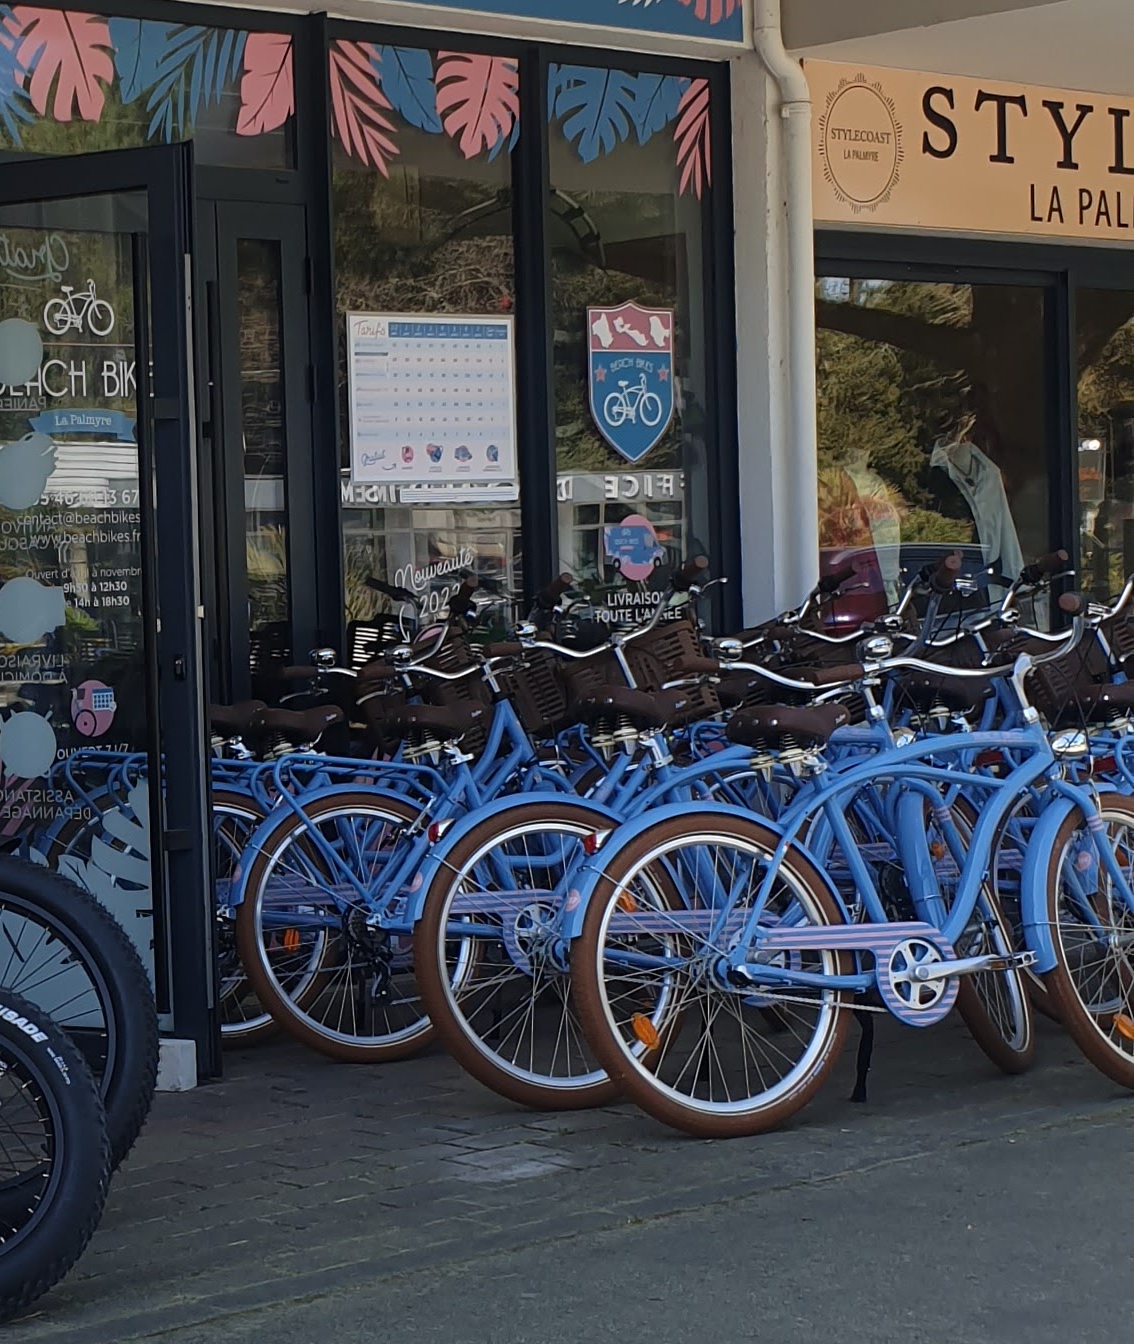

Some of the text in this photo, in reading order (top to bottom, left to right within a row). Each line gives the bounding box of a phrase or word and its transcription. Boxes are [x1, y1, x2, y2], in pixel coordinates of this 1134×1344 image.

[830, 127, 892, 145] STYLECOAST
[843, 148, 879, 162] LA PALMYRE
[1029, 183, 1134, 228] LA PAL
[54, 414, 112, 429] La Palmyre
[394, 546, 474, 591] Nouveauté
[99, 580, 128, 592] 12h30
[101, 595, 130, 607] 18h30
[594, 609, 632, 624] TOUTE
